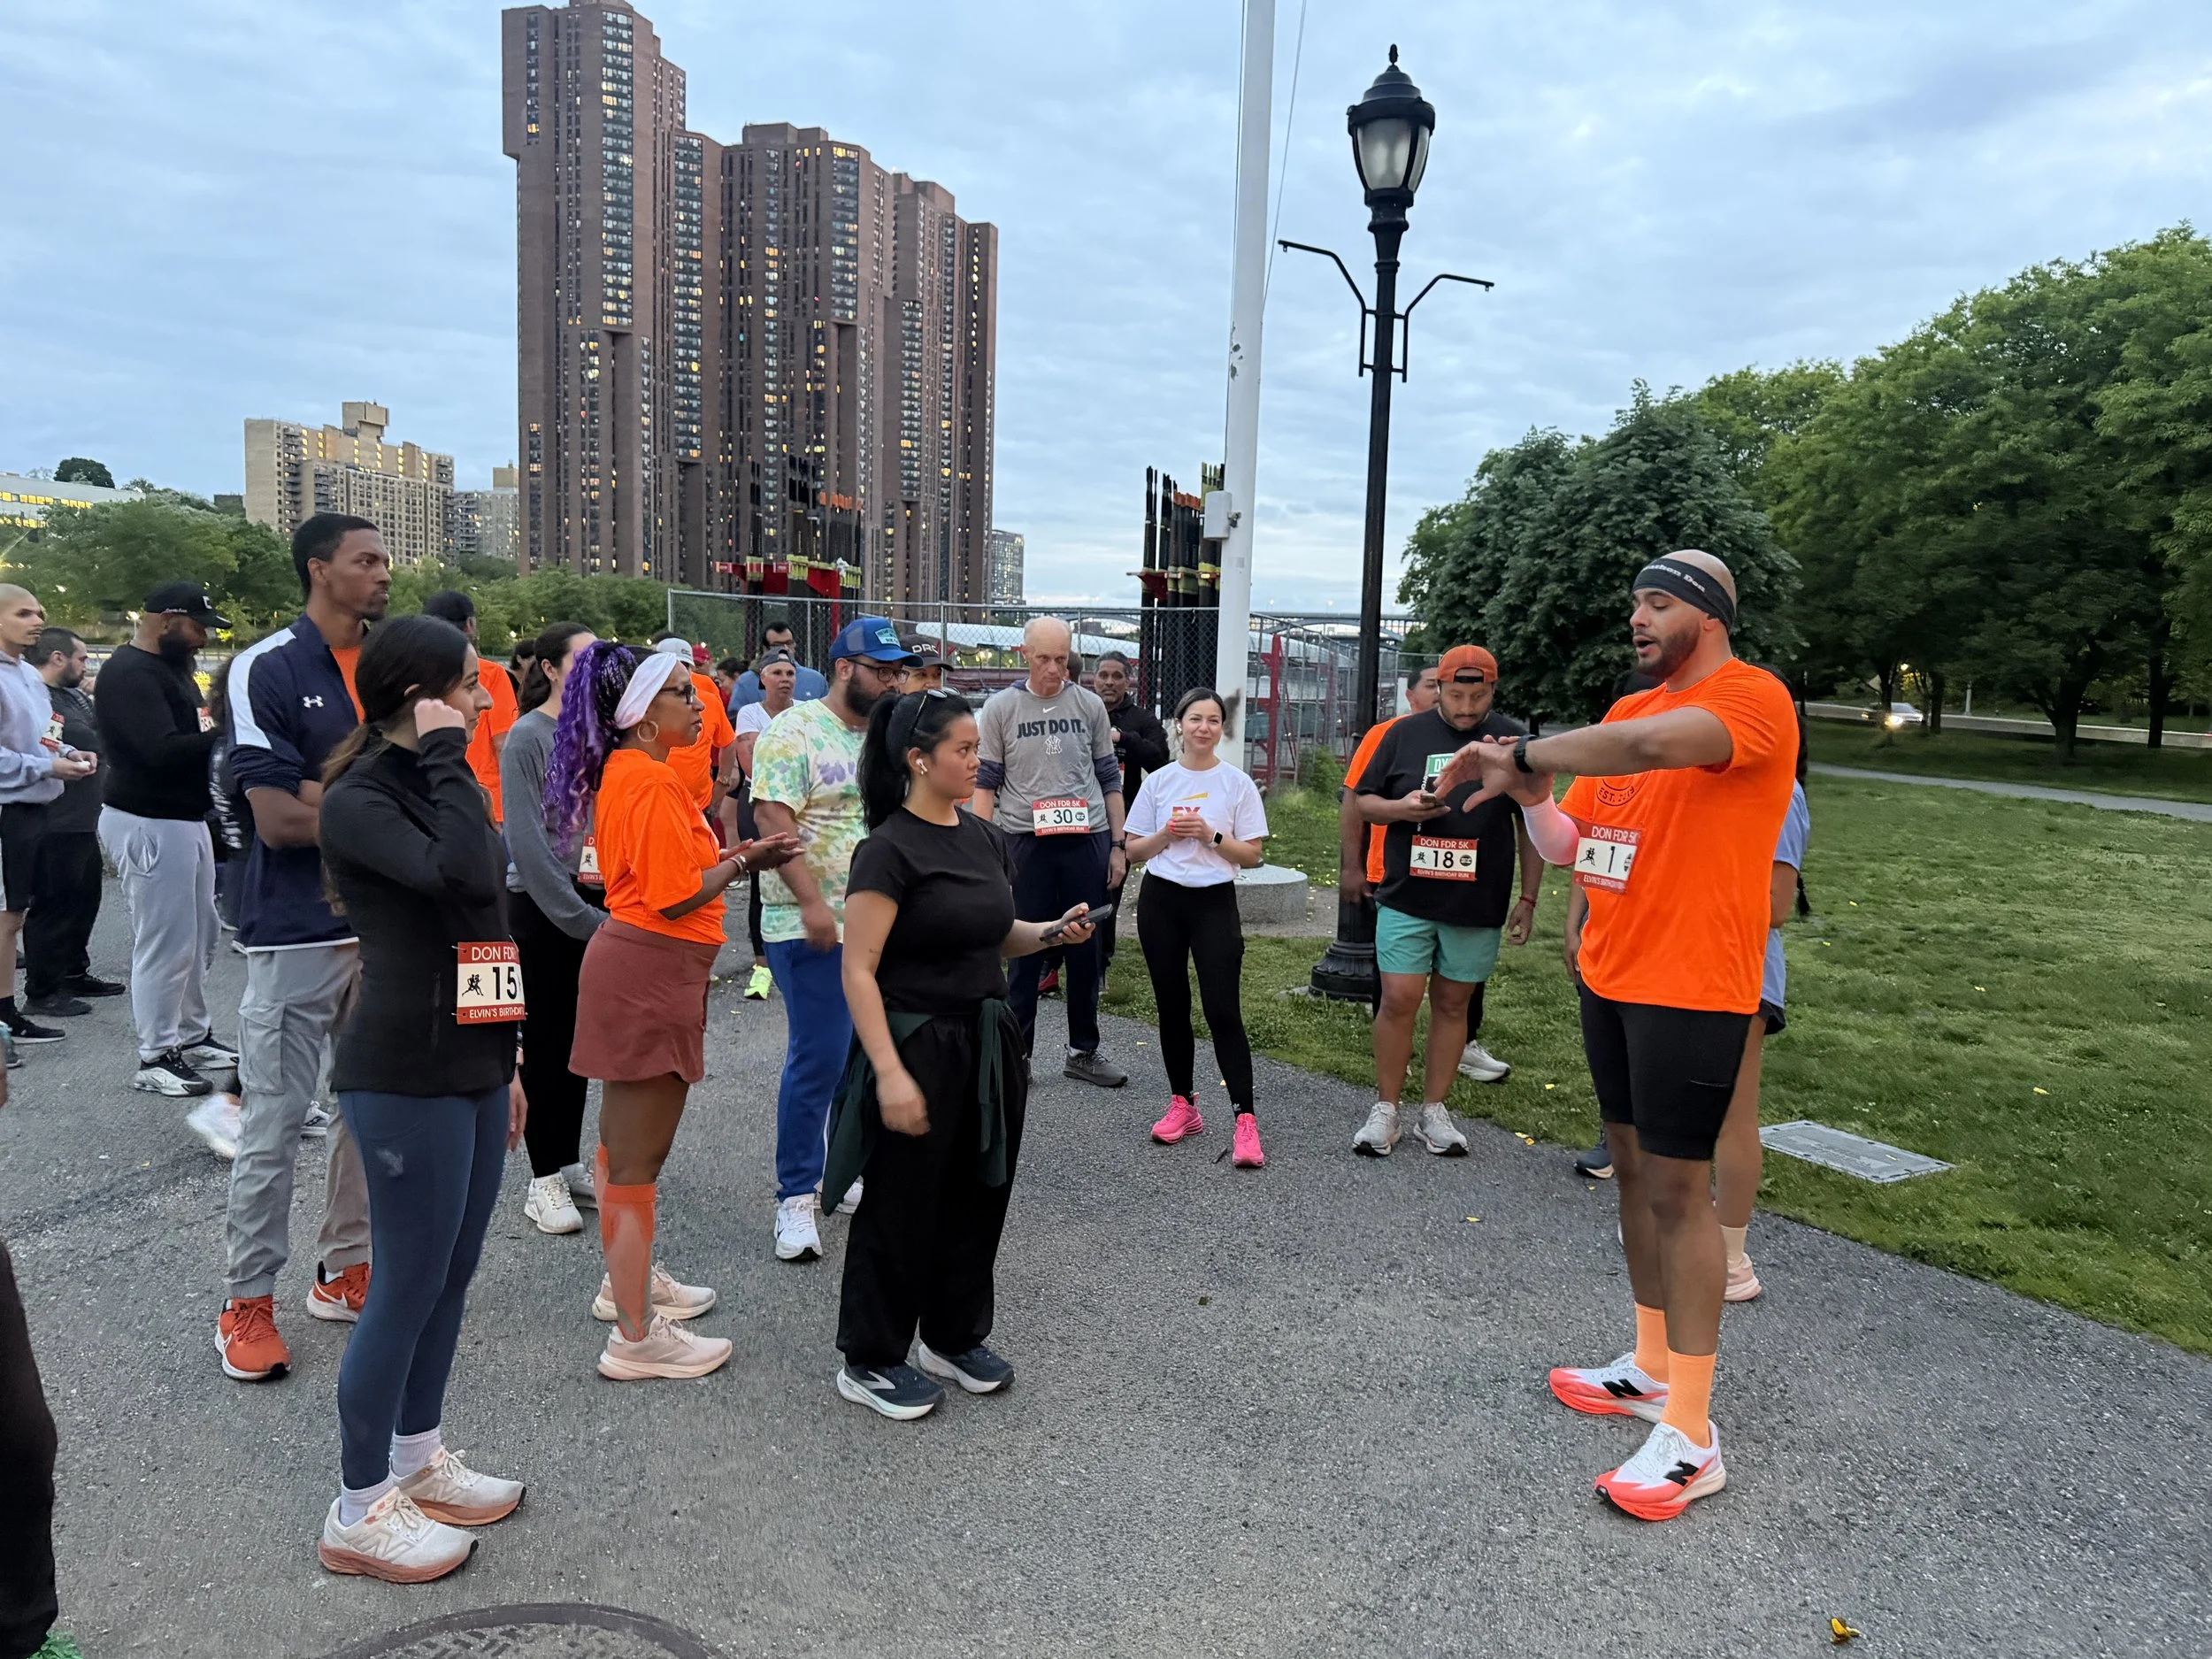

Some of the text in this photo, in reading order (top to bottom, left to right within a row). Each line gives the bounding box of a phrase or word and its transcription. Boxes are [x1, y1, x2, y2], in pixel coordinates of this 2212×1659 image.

[1017, 718, 1086, 739] JUST DO IT.
[1598, 787, 1616, 803] EST.
[1039, 801, 1056, 810] DON
[1053, 809, 1073, 825] 30
[1591, 826, 1612, 840] DON
[1613, 829, 1627, 843] FDR
[1420, 838, 1469, 849] DON FDR 5K
[1432, 850, 1454, 869] 18
[1608, 845, 1616, 873] 1
[471, 946, 501, 962] DON
[492, 966, 518, 1001] 15
[469, 1008, 498, 1019] ELVIN'S
